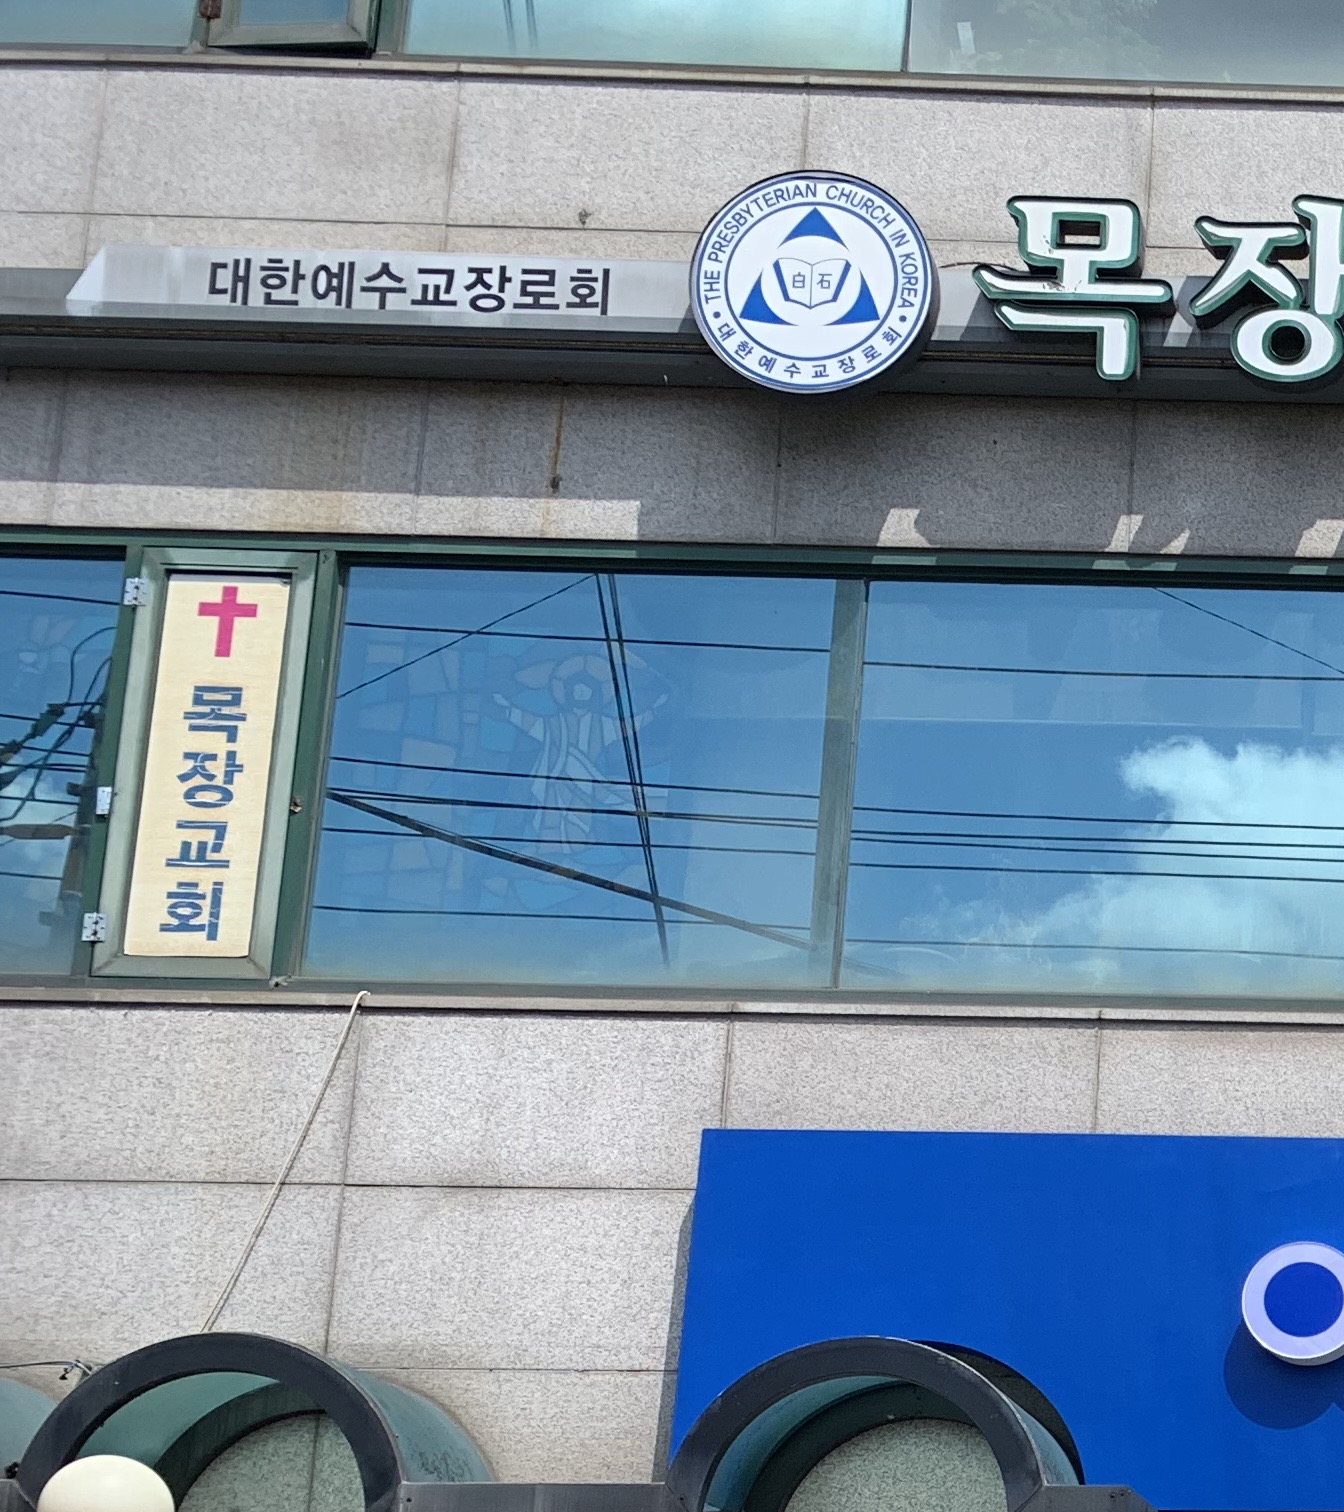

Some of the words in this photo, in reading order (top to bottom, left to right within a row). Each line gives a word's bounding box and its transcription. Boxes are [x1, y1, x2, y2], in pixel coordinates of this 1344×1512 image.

[710, 182, 818, 263] PRESBYTERIAN
[825, 185, 896, 229] CHURCH
[889, 228, 911, 249] IN
[208, 257, 610, 316] 대한예수교장로회
[703, 270, 721, 304] THE
[897, 253, 918, 309] KOREA
[718, 322, 902, 379] 대한예수교장로회
[159, 685, 247, 941] 목장교회
